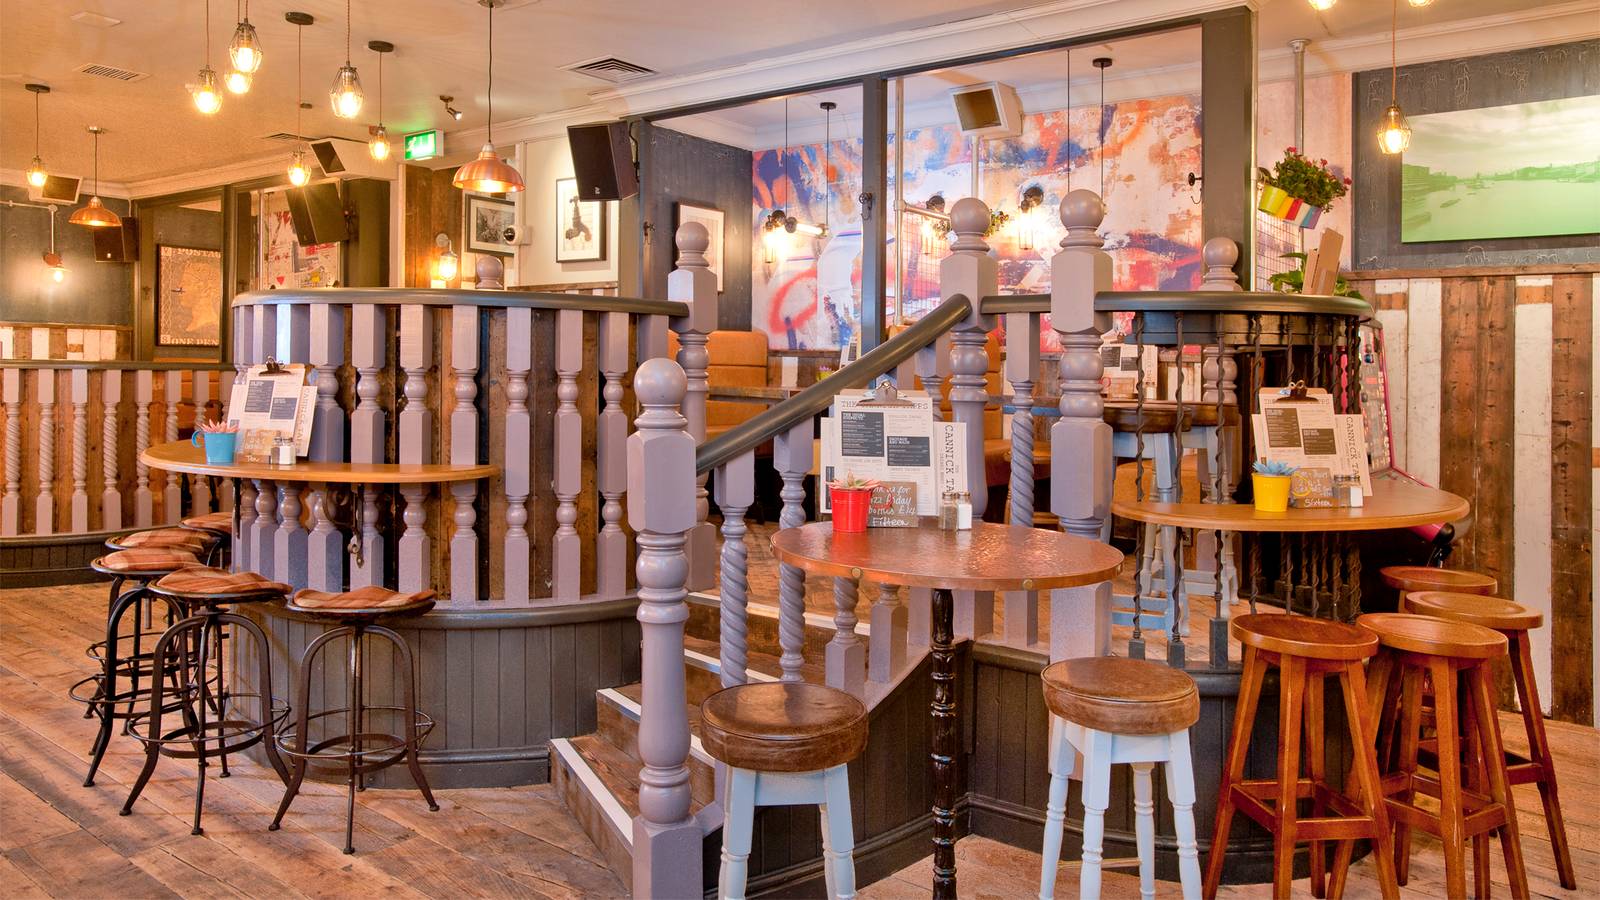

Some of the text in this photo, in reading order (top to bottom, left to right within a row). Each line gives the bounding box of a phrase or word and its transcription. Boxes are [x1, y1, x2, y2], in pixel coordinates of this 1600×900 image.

[945, 424, 954, 474] CANNICK
[1304, 497, 1332, 507] Sixteen
[872, 516, 909, 527] Fifteen
